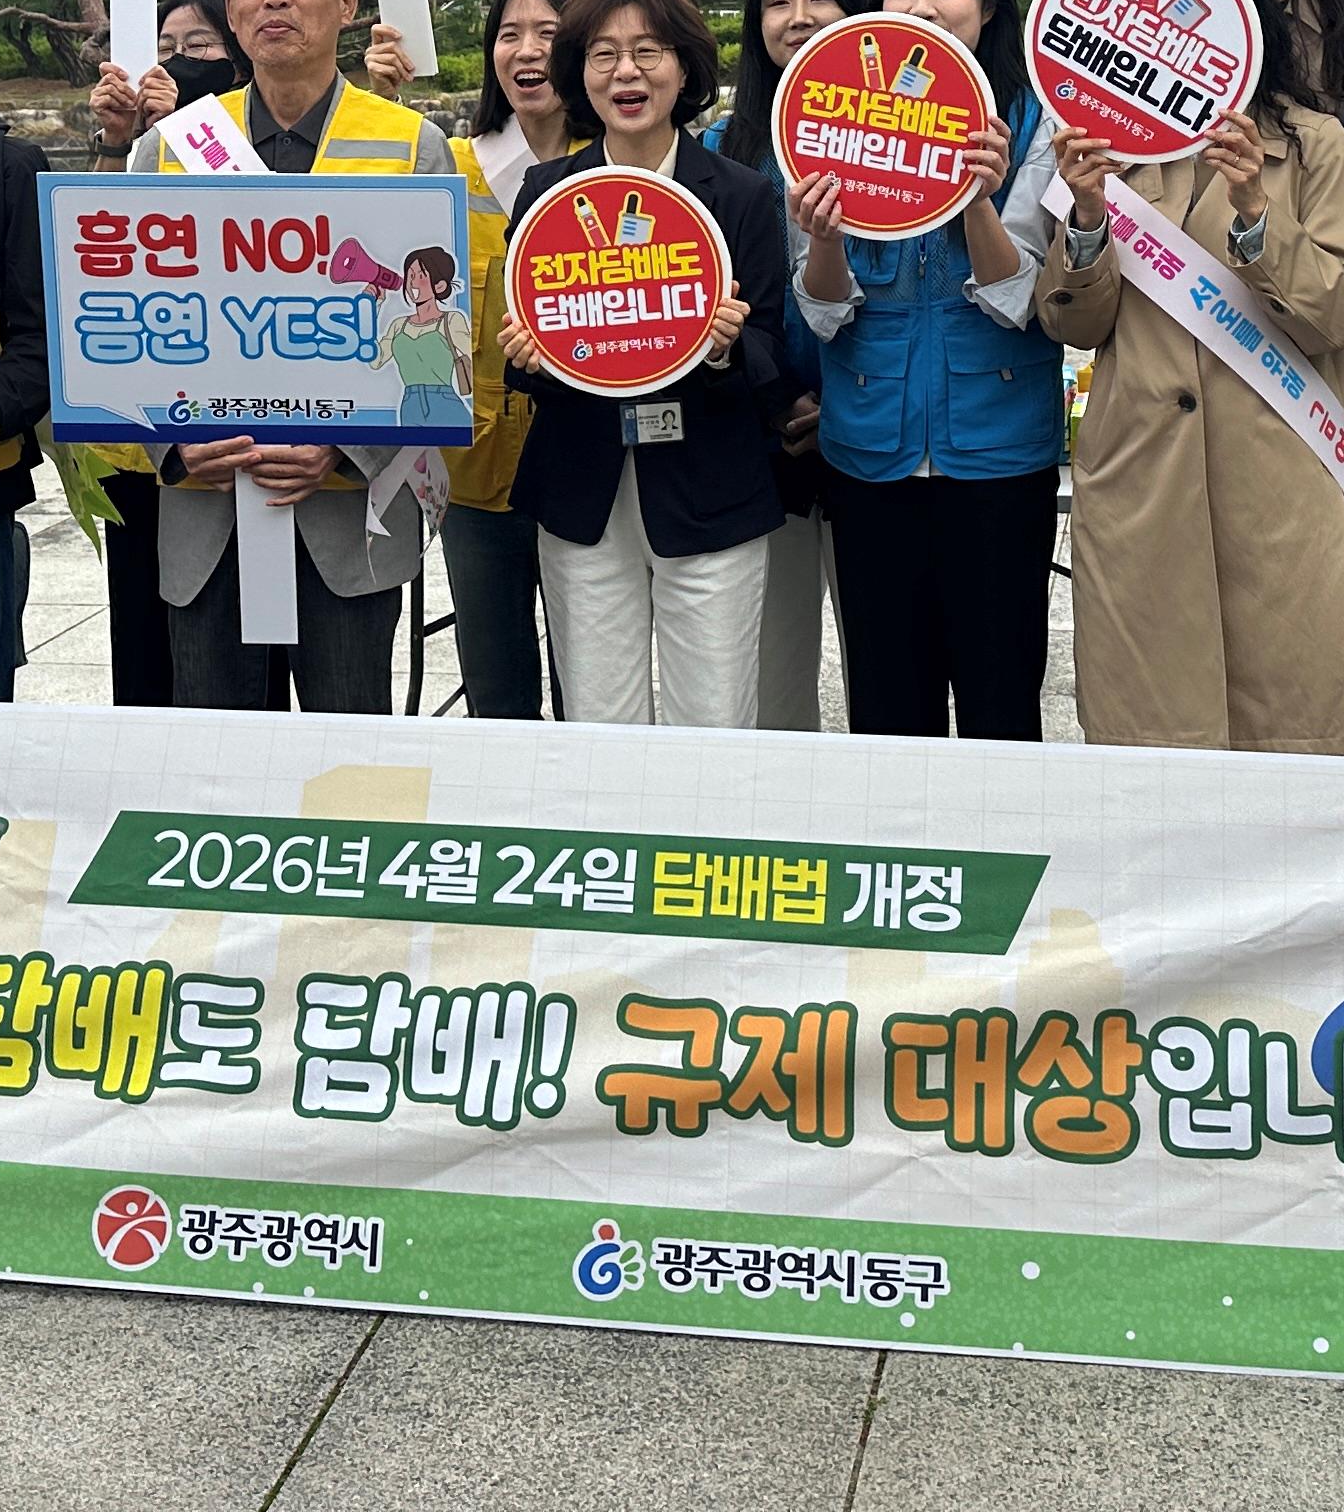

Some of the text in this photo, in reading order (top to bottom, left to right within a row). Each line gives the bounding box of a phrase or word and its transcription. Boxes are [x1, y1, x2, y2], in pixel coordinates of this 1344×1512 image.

[1041, 12, 1216, 133] 담배입니다
[801, 79, 970, 144] 전자담배도
[794, 118, 968, 185] 담배입니다
[74, 210, 330, 278] 흡연 NO!
[529, 240, 704, 291] 전자담배도
[74, 291, 379, 365] 금연 YES!
[533, 283, 708, 332] 담배입니다
[1189, 275, 1264, 353] 서로를
[147, 829, 965, 932] 2026년 4월 24일 담배법 개정
[292, 970, 578, 1132] 담배!
[596, 994, 855, 1149] 규제
[179, 1206, 381, 1268] 광주광역시
